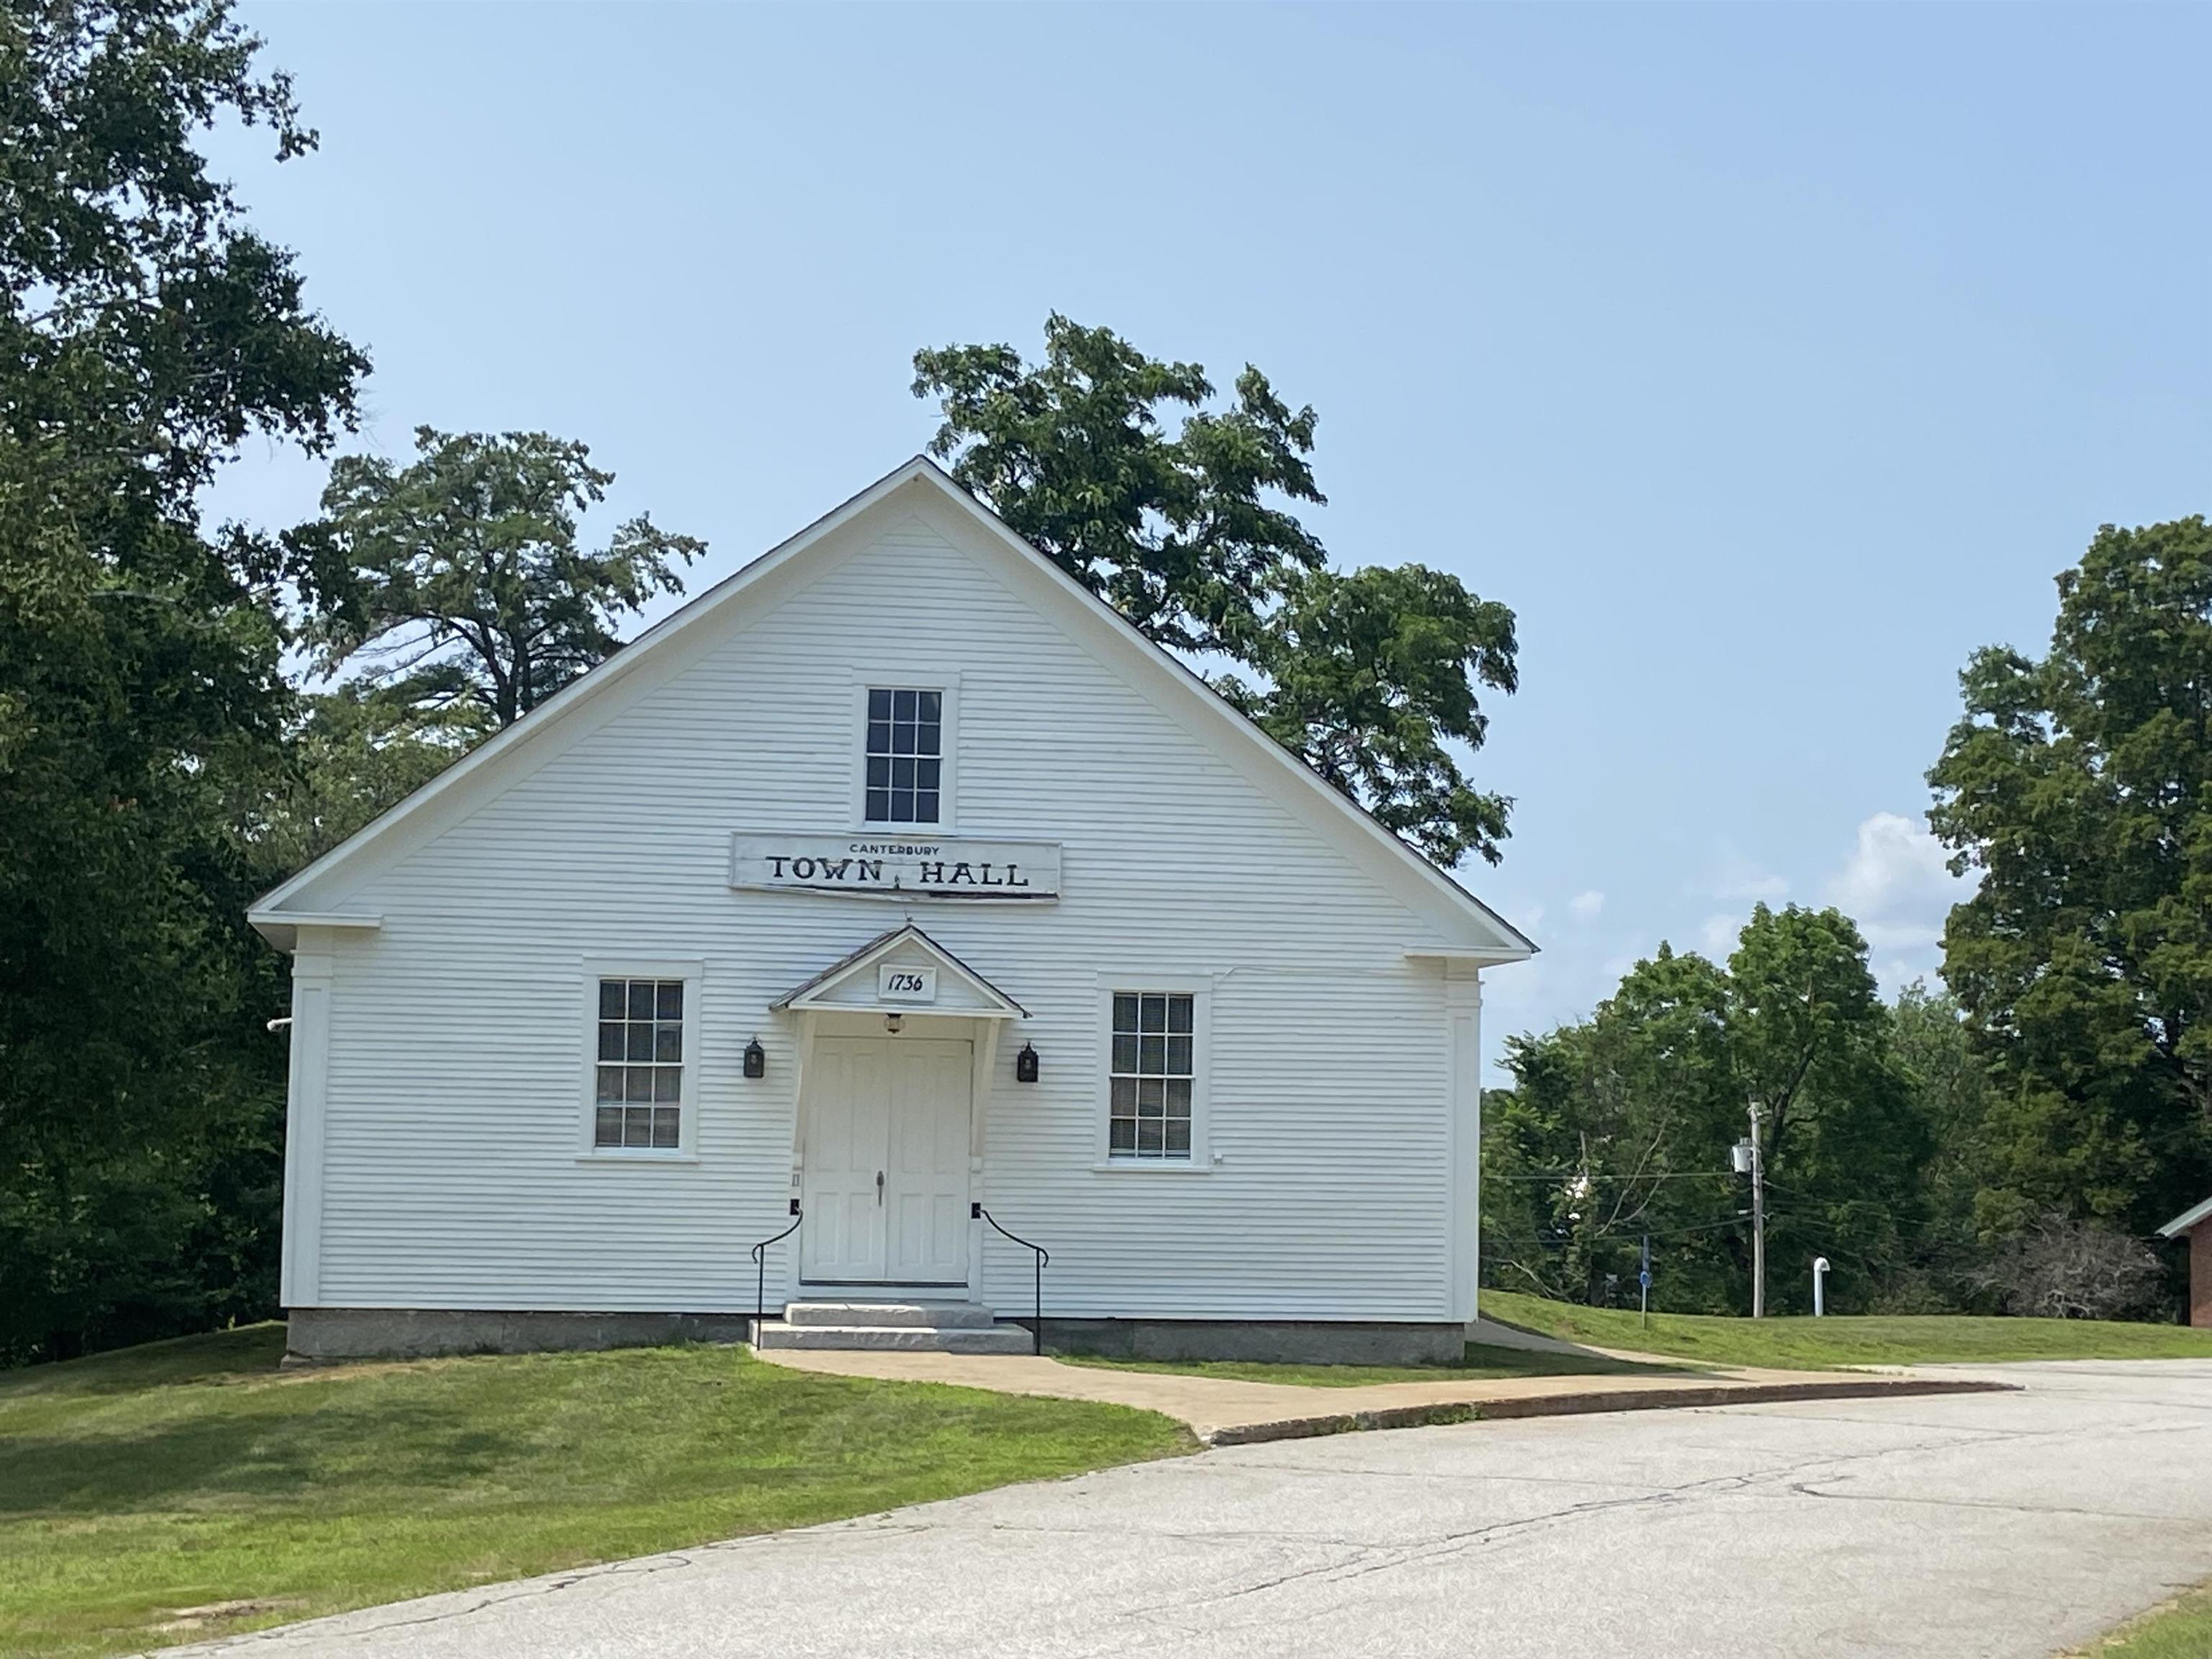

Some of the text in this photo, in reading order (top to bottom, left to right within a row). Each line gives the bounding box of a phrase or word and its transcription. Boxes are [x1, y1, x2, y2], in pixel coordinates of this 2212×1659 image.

[850, 844, 940, 856] CANTERBURY
[765, 856, 1030, 886] TOWN HALL
[888, 974, 924, 992] 1736
